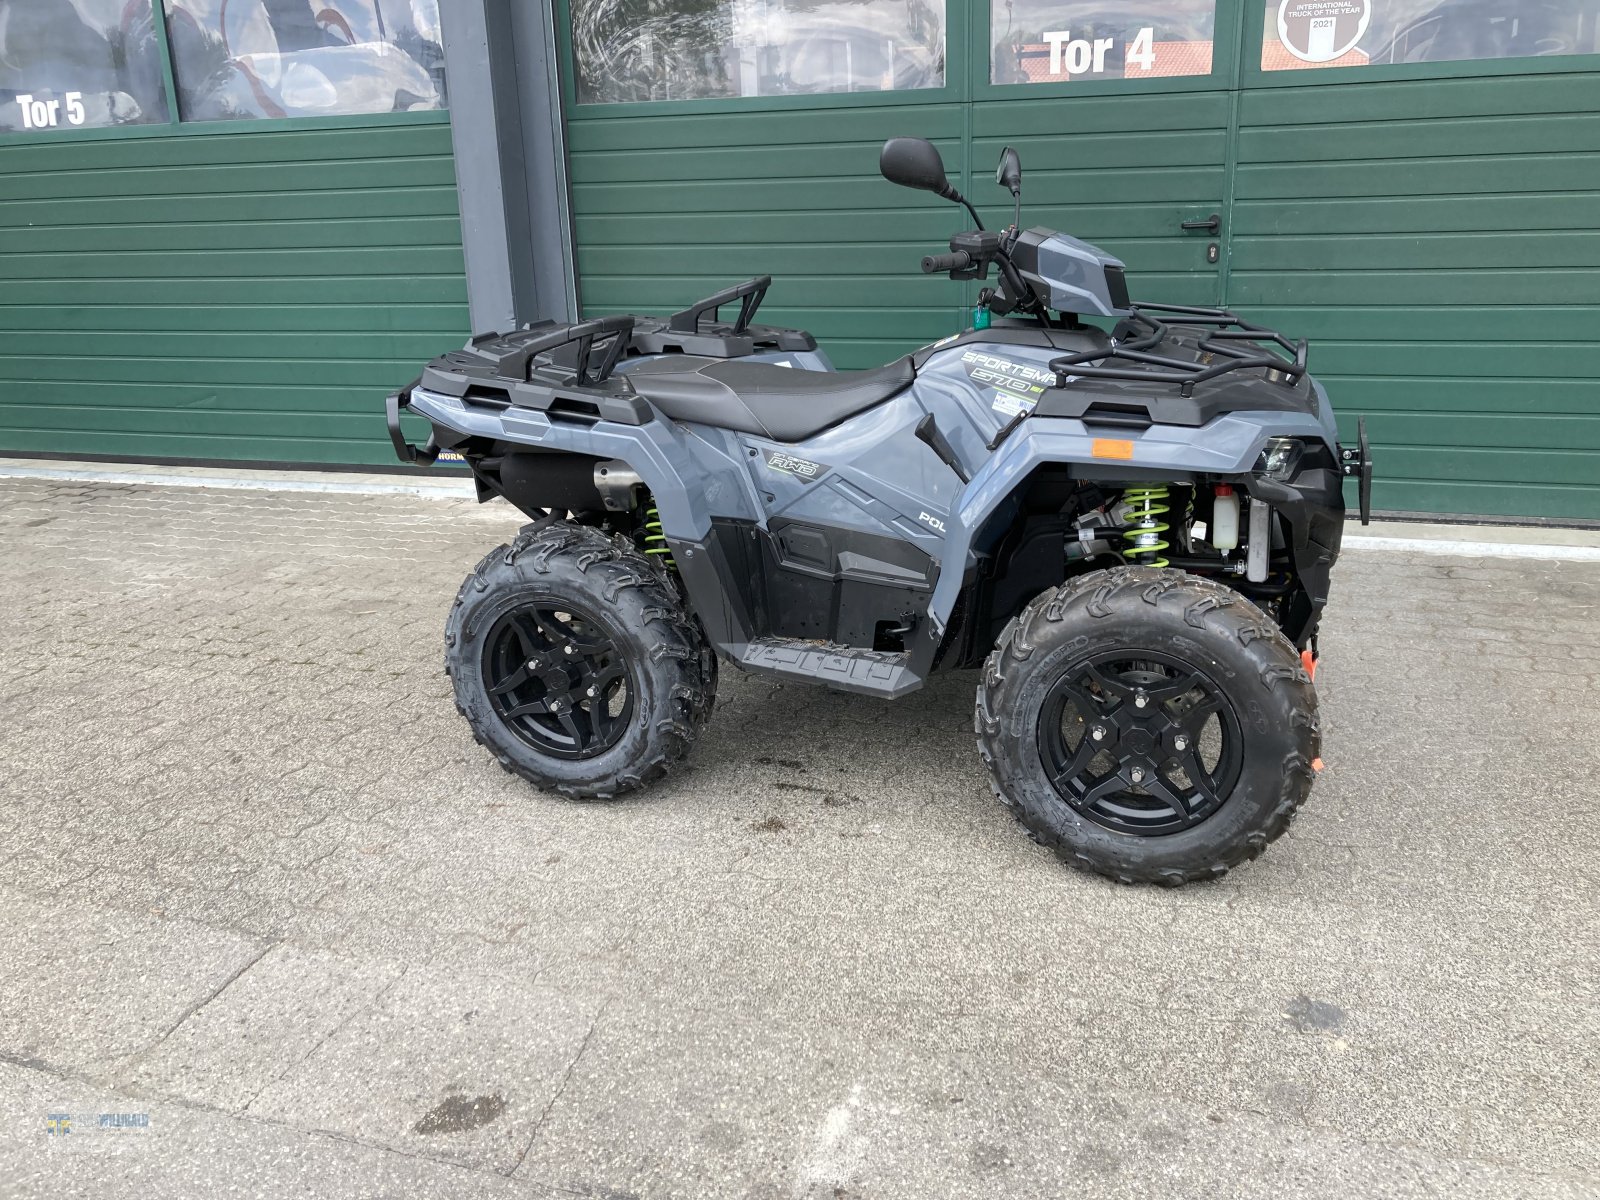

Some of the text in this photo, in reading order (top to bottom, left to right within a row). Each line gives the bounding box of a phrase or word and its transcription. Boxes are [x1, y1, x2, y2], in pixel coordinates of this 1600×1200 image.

[1288, 10, 1312, 18] TRUCK
[1296, 1, 1353, 11] INTERNATIONAL
[1312, 20, 1334, 28] 2021
[1042, 27, 1156, 75] Tor 4
[15, 91, 86, 128] Tor 5
[960, 351, 1057, 386] SPORTSMA
[969, 367, 1032, 393] 570
[768, 456, 817, 477] AWD
[918, 511, 947, 533] POL
